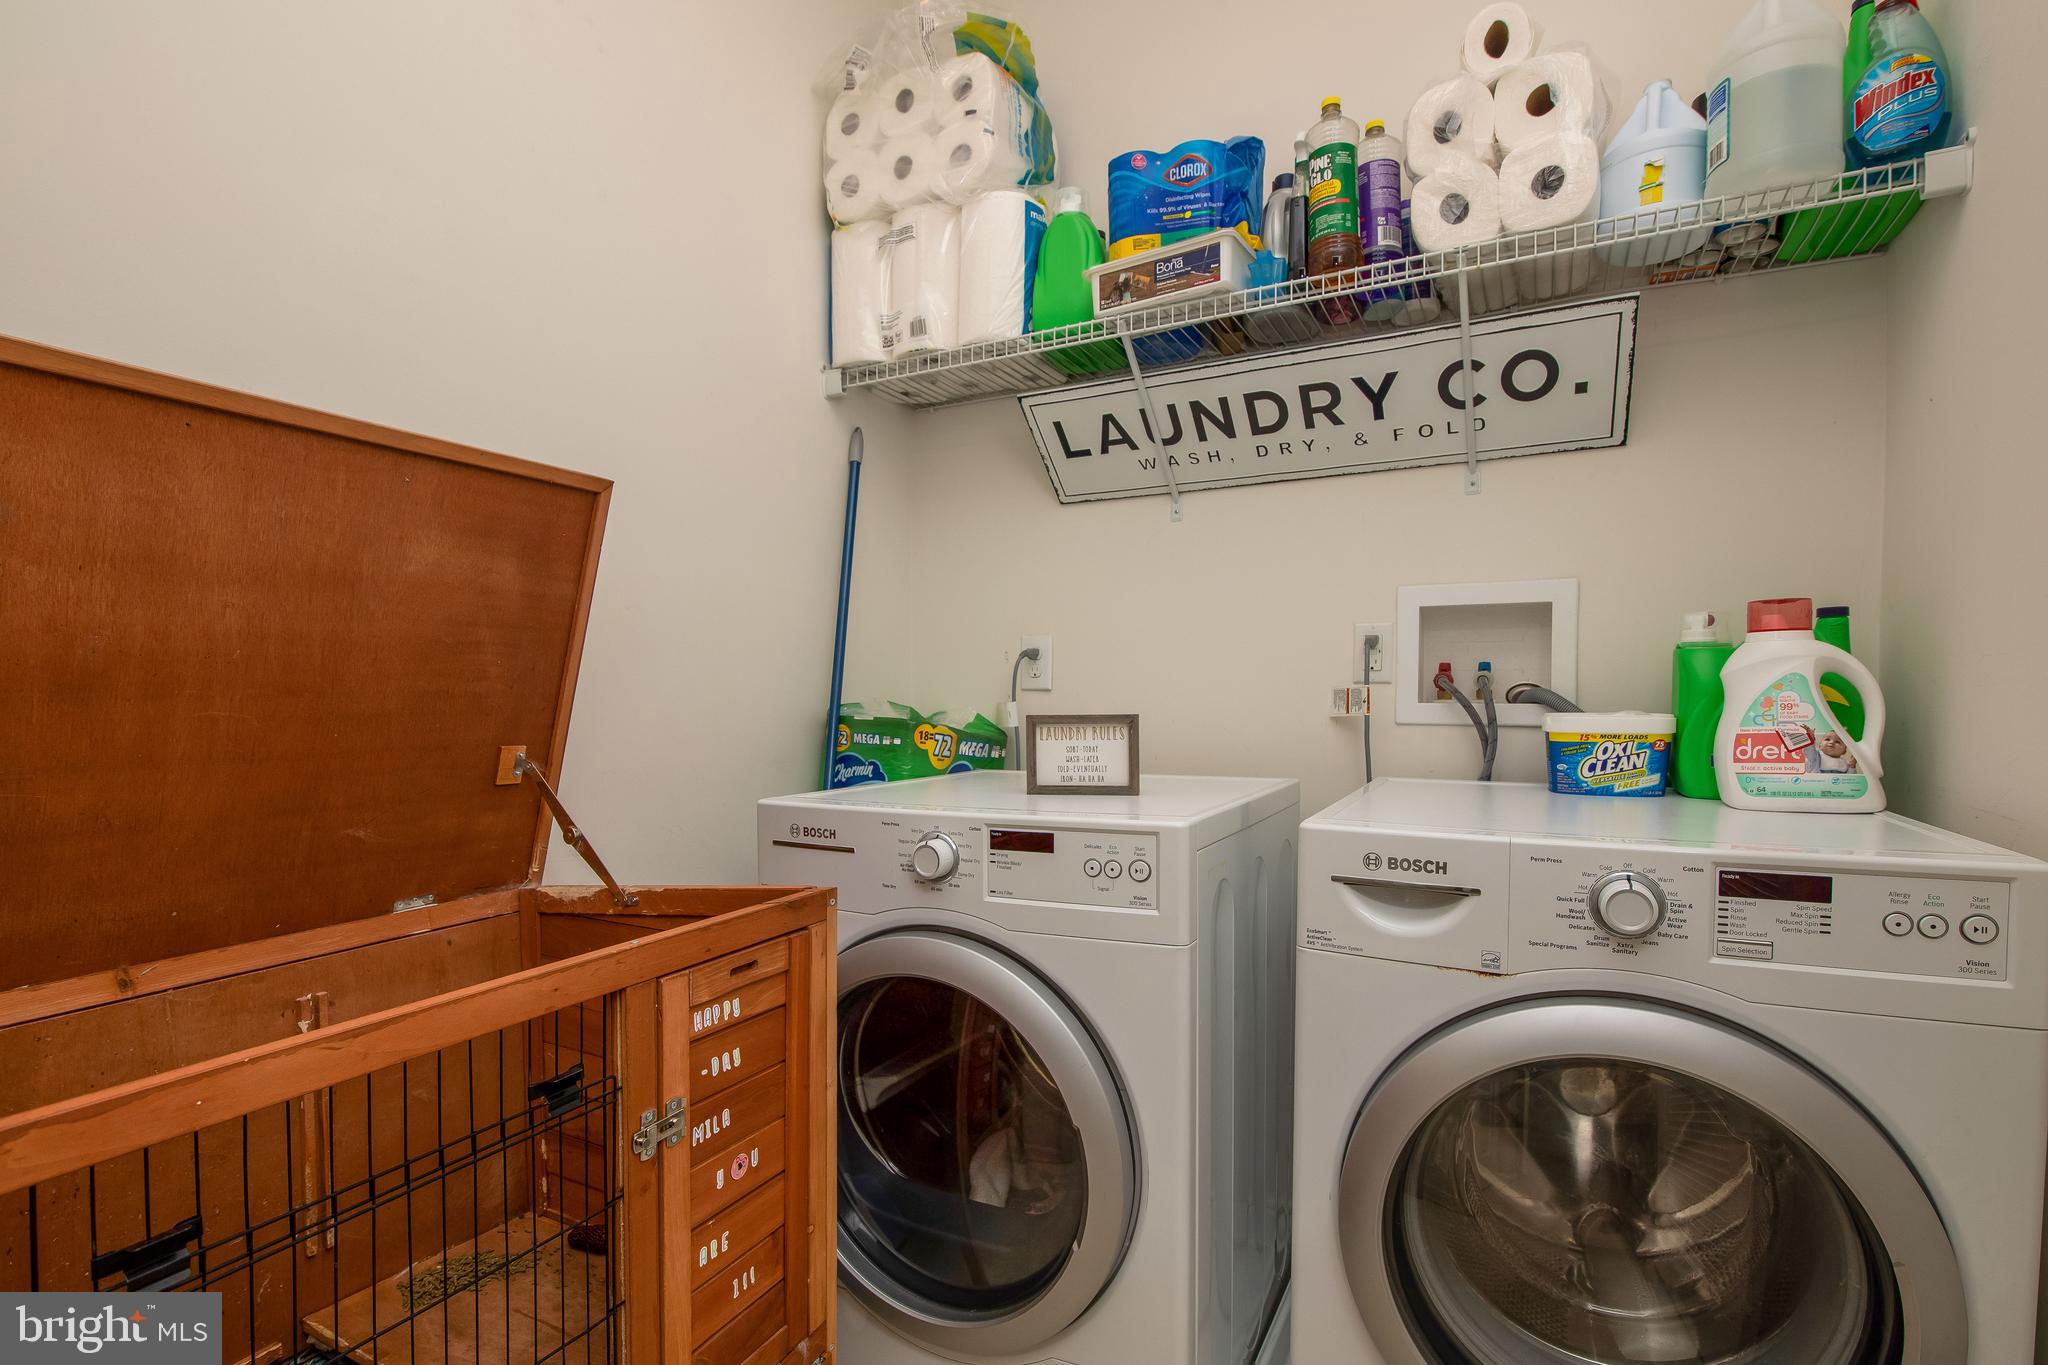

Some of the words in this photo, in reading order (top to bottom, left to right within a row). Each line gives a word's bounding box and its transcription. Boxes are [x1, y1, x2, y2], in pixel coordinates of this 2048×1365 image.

[1854, 67, 1936, 132] Windex
[1878, 86, 1937, 120] PLUS
[1309, 154, 1331, 176] PINE
[1169, 162, 1207, 181] CLOROX
[1311, 169, 1331, 188] GLO
[1156, 259, 1183, 274] Bona
[1052, 370, 1399, 460] LAUNDRY
[1437, 349, 1589, 410] CO.
[1138, 449, 1236, 471] WASH,
[1256, 438, 1332, 458] DRY,
[1353, 430, 1369, 447] &
[1393, 417, 1487, 442] FOLD
[1780, 702, 1799, 711] 99%
[854, 733, 880, 745] MEGA
[1040, 726, 1087, 741] LAUNDRY
[1092, 726, 1126, 741] RULES
[1579, 733, 1597, 742] 15%
[933, 733, 953, 758] 72
[958, 740, 989, 758] MEGA
[1595, 740, 1635, 760] OXI
[1580, 751, 1648, 779] CLEAN
[834, 761, 874, 783] Charmin
[1617, 779, 1640, 790] FREE
[803, 826, 836, 840] BOSCH
[1387, 857, 1448, 875] BOSCH
[1888, 891, 1911, 900] Allergy
[1730, 906, 1745, 914] Spin
[1796, 904, 1811, 912] Spin
[1811, 905, 1832, 913] Speed
[1555, 913, 1586, 921] Handwash
[1775, 918, 1803, 926] Reduced
[1729, 921, 1746, 929] Wash
[1782, 926, 1803, 934] Gentle
[1657, 932, 1673, 940] Baby
[1745, 930, 1768, 938] Locked
[1549, 942, 1577, 951] Programs
[1586, 940, 1610, 948] Sanitize
[1641, 939, 1659, 947] Jeans
[1612, 948, 1638, 956] Sanitary
[1722, 945, 1737, 953] Spin
[1737, 947, 1768, 955] Selection
[1958, 966, 1973, 974] 300
[1974, 968, 1997, 976] Series
[692, 1108, 731, 1147] MILA
[699, 1230, 729, 1268] ARE
